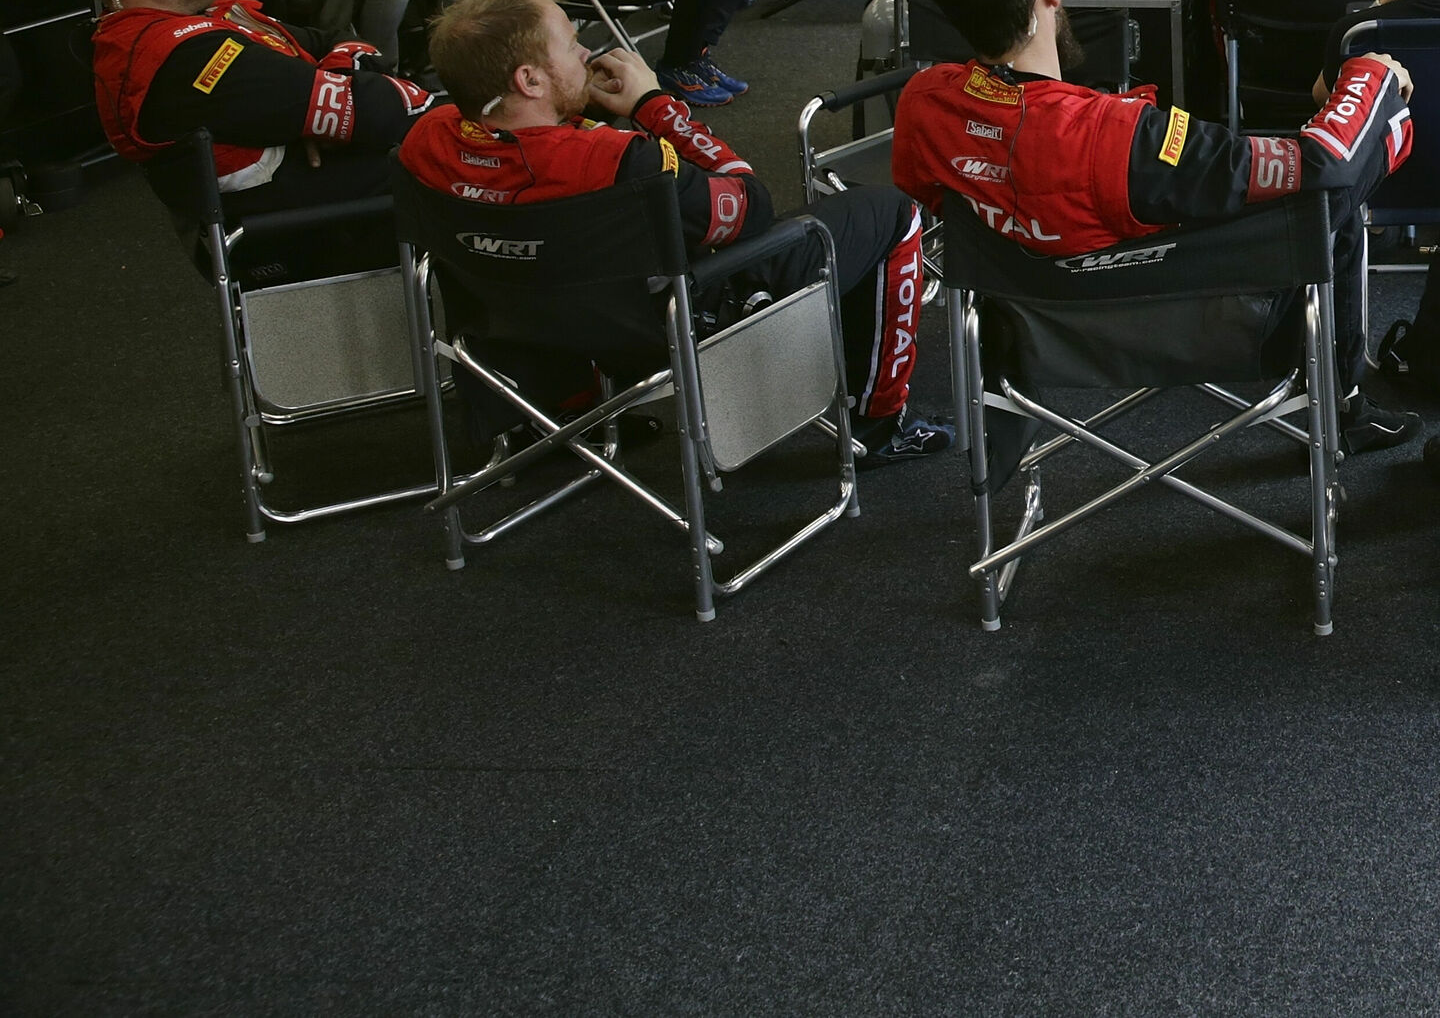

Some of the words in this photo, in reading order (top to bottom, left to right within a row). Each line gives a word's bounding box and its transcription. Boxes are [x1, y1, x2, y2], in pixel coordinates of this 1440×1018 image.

[200, 44, 237, 88] PIRELLI
[1324, 71, 1372, 125] TOTAL
[1165, 113, 1188, 159] PIRELLI
[962, 159, 1010, 179] WRT
[462, 185, 510, 202] WRT
[962, 193, 1062, 241] TAL
[472, 235, 545, 257] WRT
[1081, 242, 1177, 268] WRT
[891, 251, 918, 378] TOTAL
